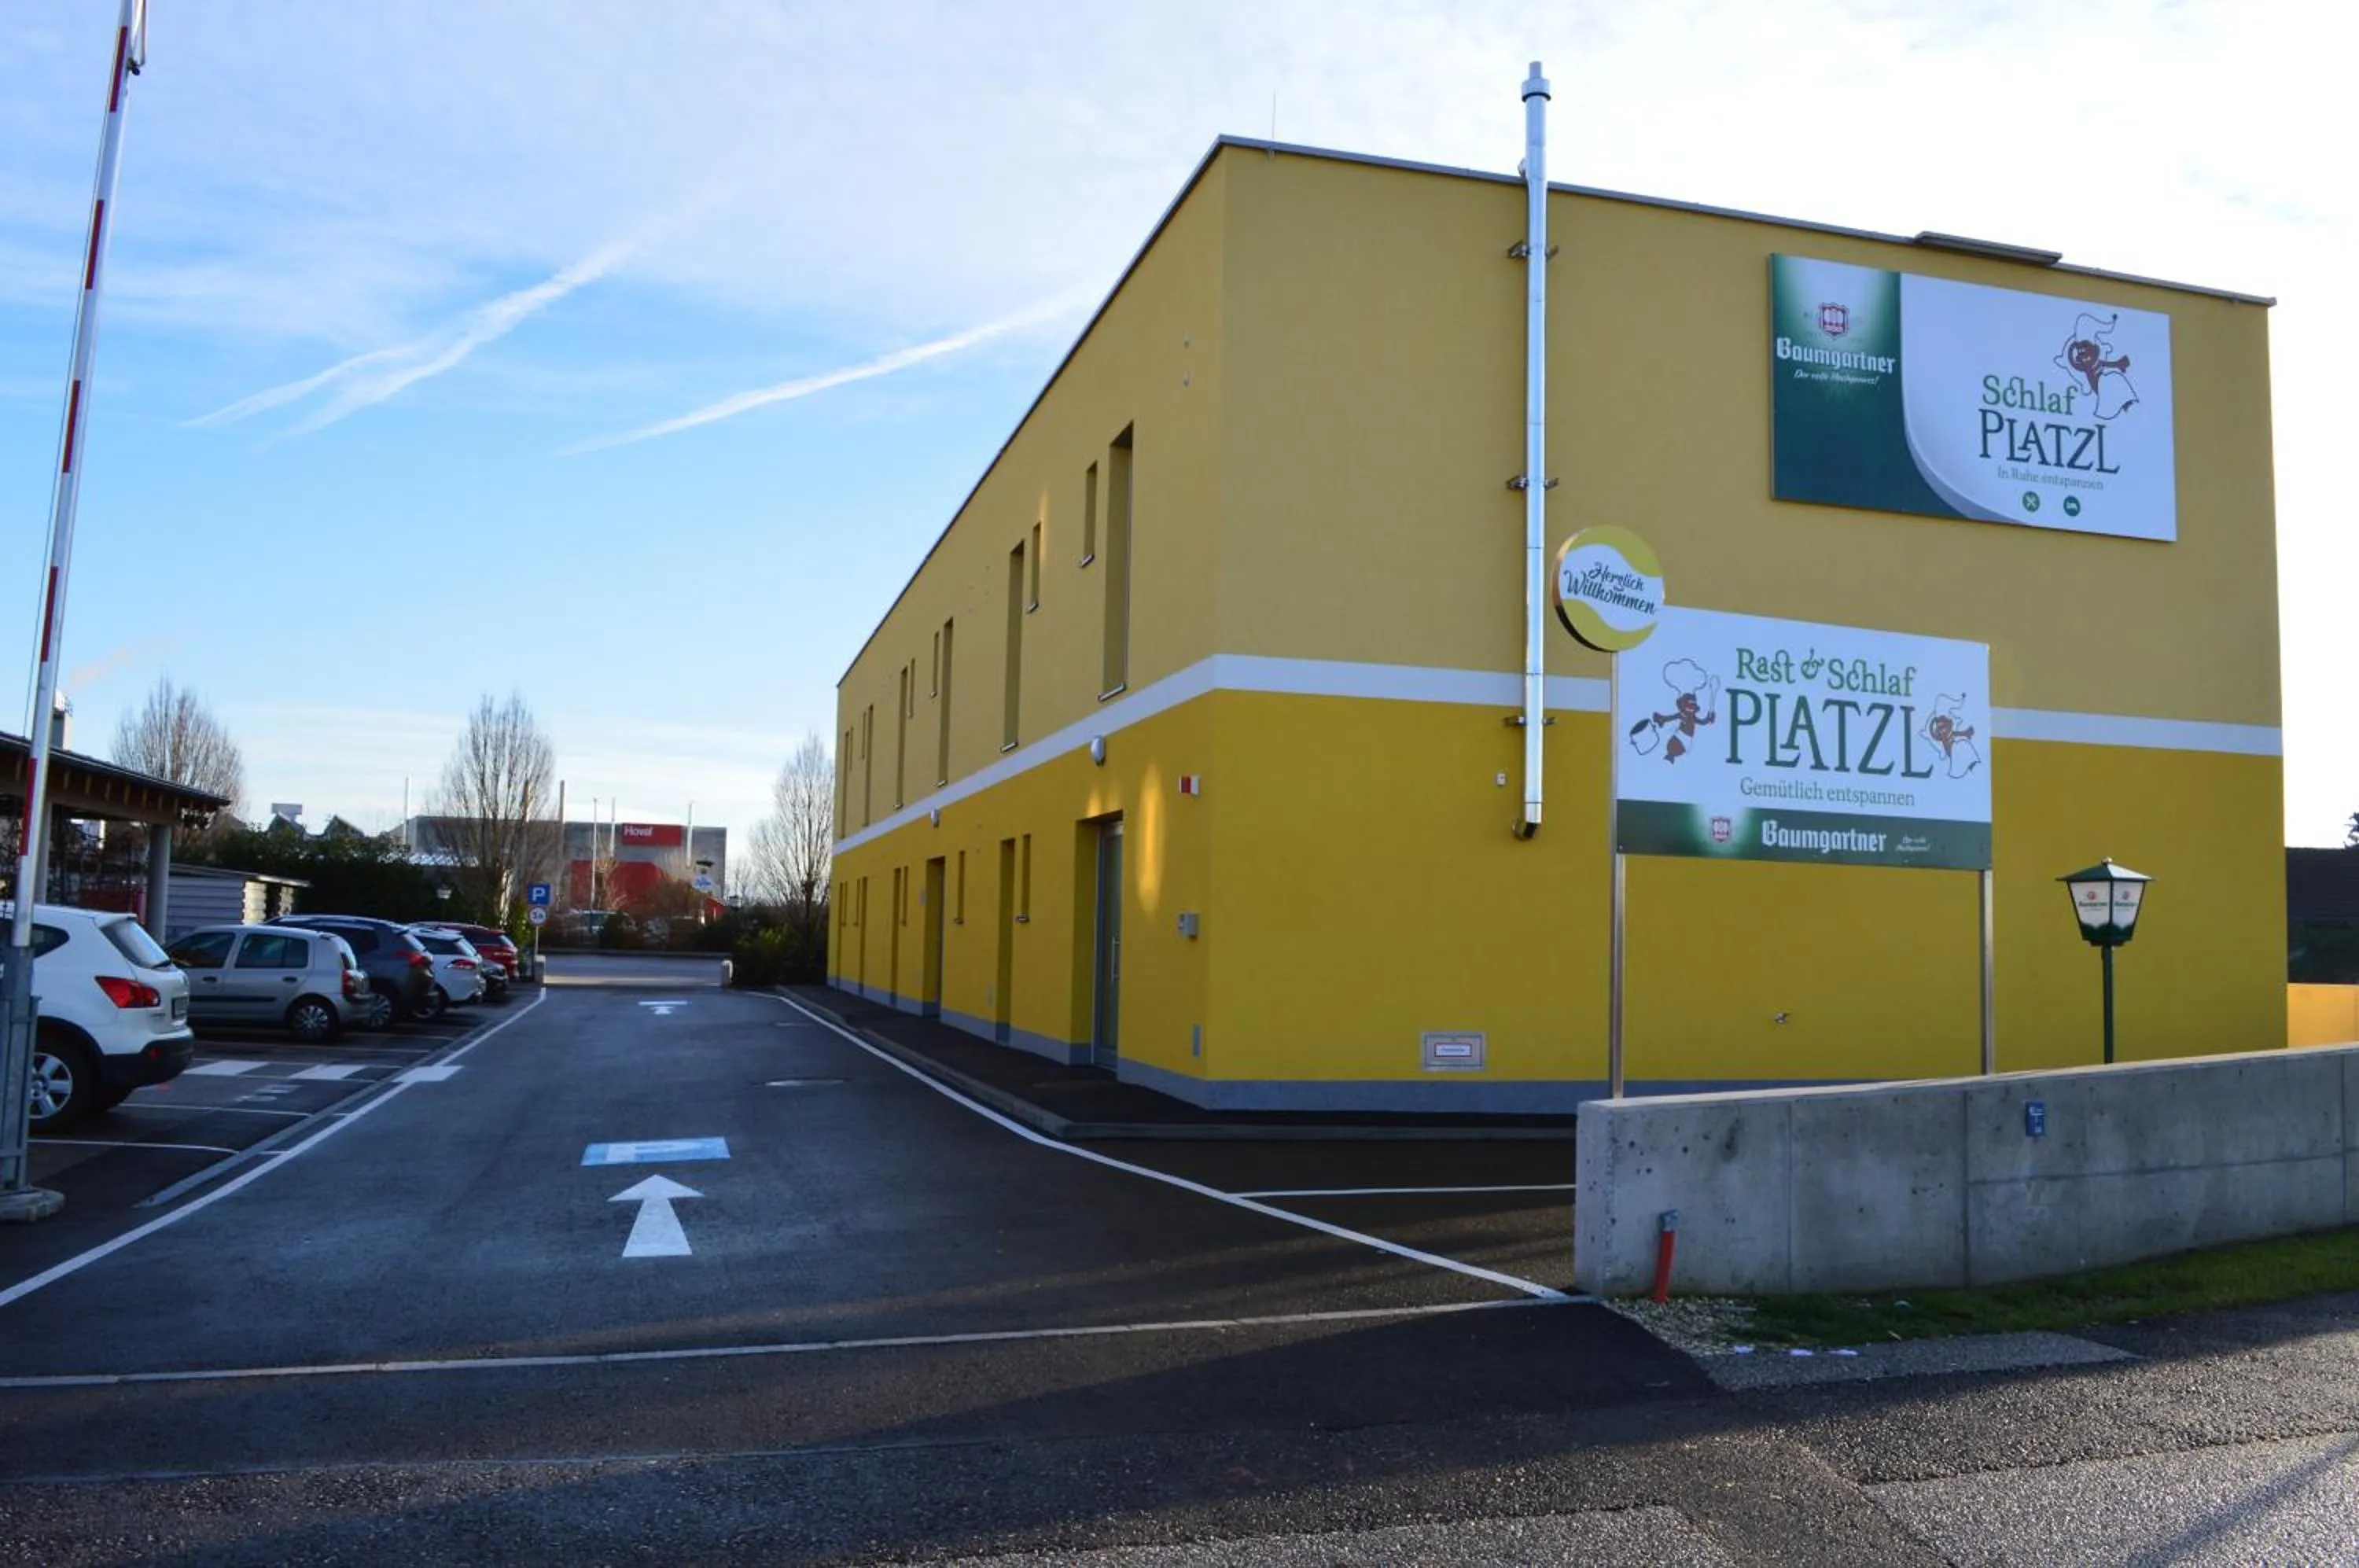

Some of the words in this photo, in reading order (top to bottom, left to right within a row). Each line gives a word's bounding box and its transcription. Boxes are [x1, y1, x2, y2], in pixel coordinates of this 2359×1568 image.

[1776, 337, 1896, 374] Baumgartner
[1982, 374, 2078, 415] Schlaf
[1978, 408, 2121, 475] PLATZL
[1998, 466, 2009, 479] In
[2011, 468, 2039, 483] Ruhe
[2042, 473, 2103, 491] entspannen
[1563, 569, 1656, 615] Willkommen
[1588, 561, 1644, 592] Herzlich
[1735, 647, 1796, 684] Rast
[1800, 647, 1824, 679] &
[1827, 658, 1916, 697] Schlaf
[1725, 688, 1934, 779] PLATZL
[1740, 776, 1823, 801] Gemütlich
[1827, 787, 1915, 806] entspannen
[1761, 819, 1887, 854] Baumgartner
[532, 887, 546, 902] P
